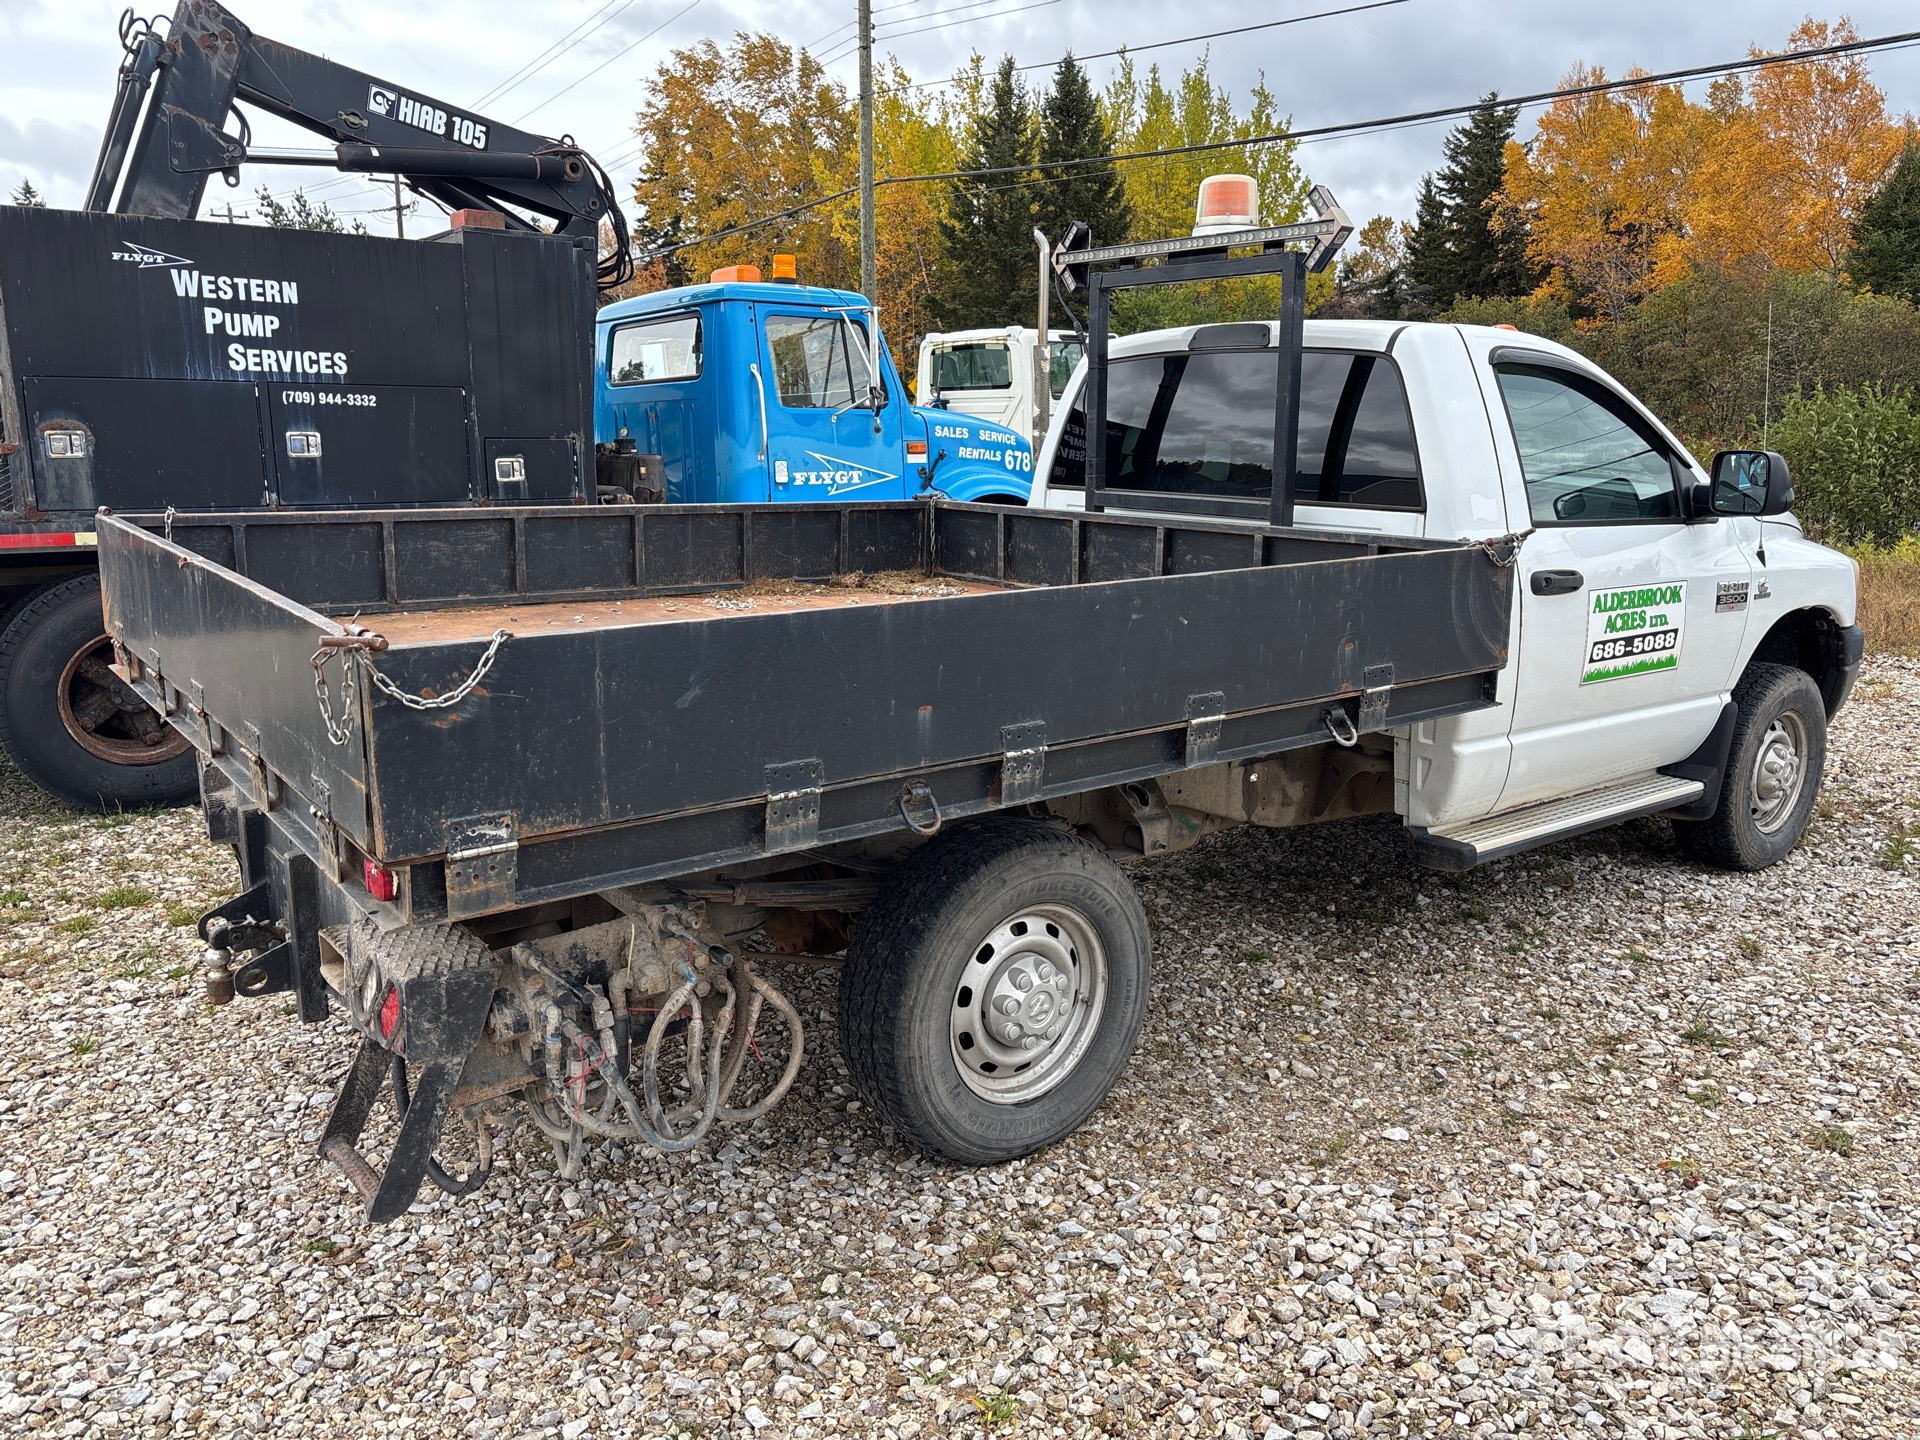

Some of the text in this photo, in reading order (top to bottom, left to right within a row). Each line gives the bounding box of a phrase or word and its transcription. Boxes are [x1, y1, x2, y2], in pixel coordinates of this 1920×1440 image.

[398, 95, 487, 149] HIAB 105
[111, 251, 166, 264] FLYGT
[170, 268, 299, 304] WESTERN
[203, 307, 280, 338] PUMP
[227, 343, 348, 375] SERVICES
[282, 391, 377, 407] (709) 944-3332
[934, 425, 1016, 446] SALES SERVICE
[958, 446, 1001, 462] RENTALS
[1004, 450, 1031, 472] 678
[793, 470, 862, 486] FLYGT
[1593, 585, 1683, 614] ALDERBROOK
[1719, 594, 1746, 604] 3500
[1604, 610, 1669, 634] ACRES LTD.
[1592, 632, 1676, 661] 686-5088
